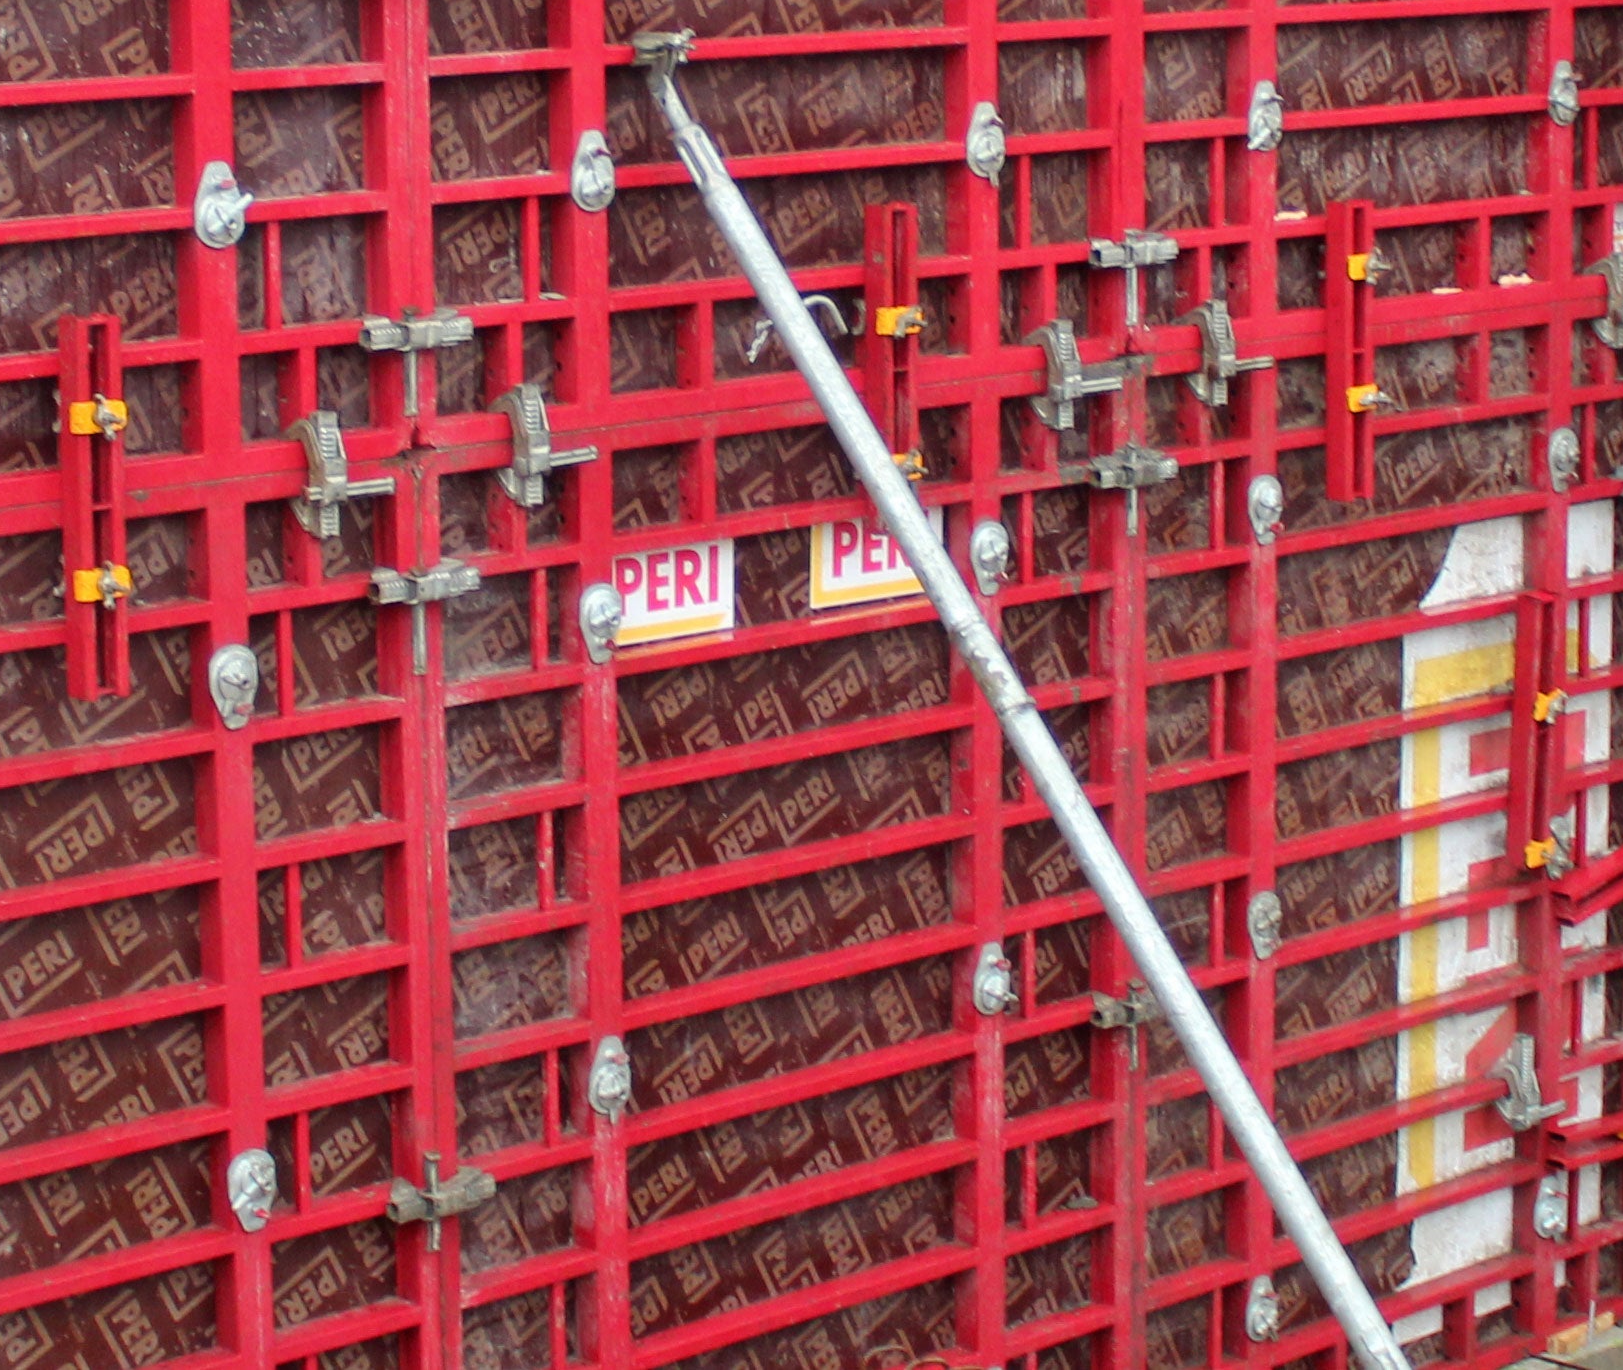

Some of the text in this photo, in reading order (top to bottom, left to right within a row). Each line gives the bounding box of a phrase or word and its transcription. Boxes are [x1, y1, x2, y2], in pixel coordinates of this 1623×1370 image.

[433, 104, 471, 178] PER
[781, 190, 828, 238] PERI
[446, 214, 516, 273] PERI
[1395, 440, 1435, 487] PERI
[617, 544, 719, 620] PERI
[320, 608, 370, 663] ERI
[651, 674, 708, 729] PERI
[806, 674, 865, 728] PERI
[781, 770, 837, 829] PERI
[36, 818, 107, 880] PERI
[711, 817, 769, 866] PERI
[102, 904, 148, 958] ERI
[690, 911, 744, 974] PERI
[8, 934, 73, 1001] PERI
[659, 1048, 718, 1104] PERI
[310, 1117, 369, 1182] PERI
[39, 1169, 86, 1225] ERI
[634, 1153, 691, 1218] PERI
